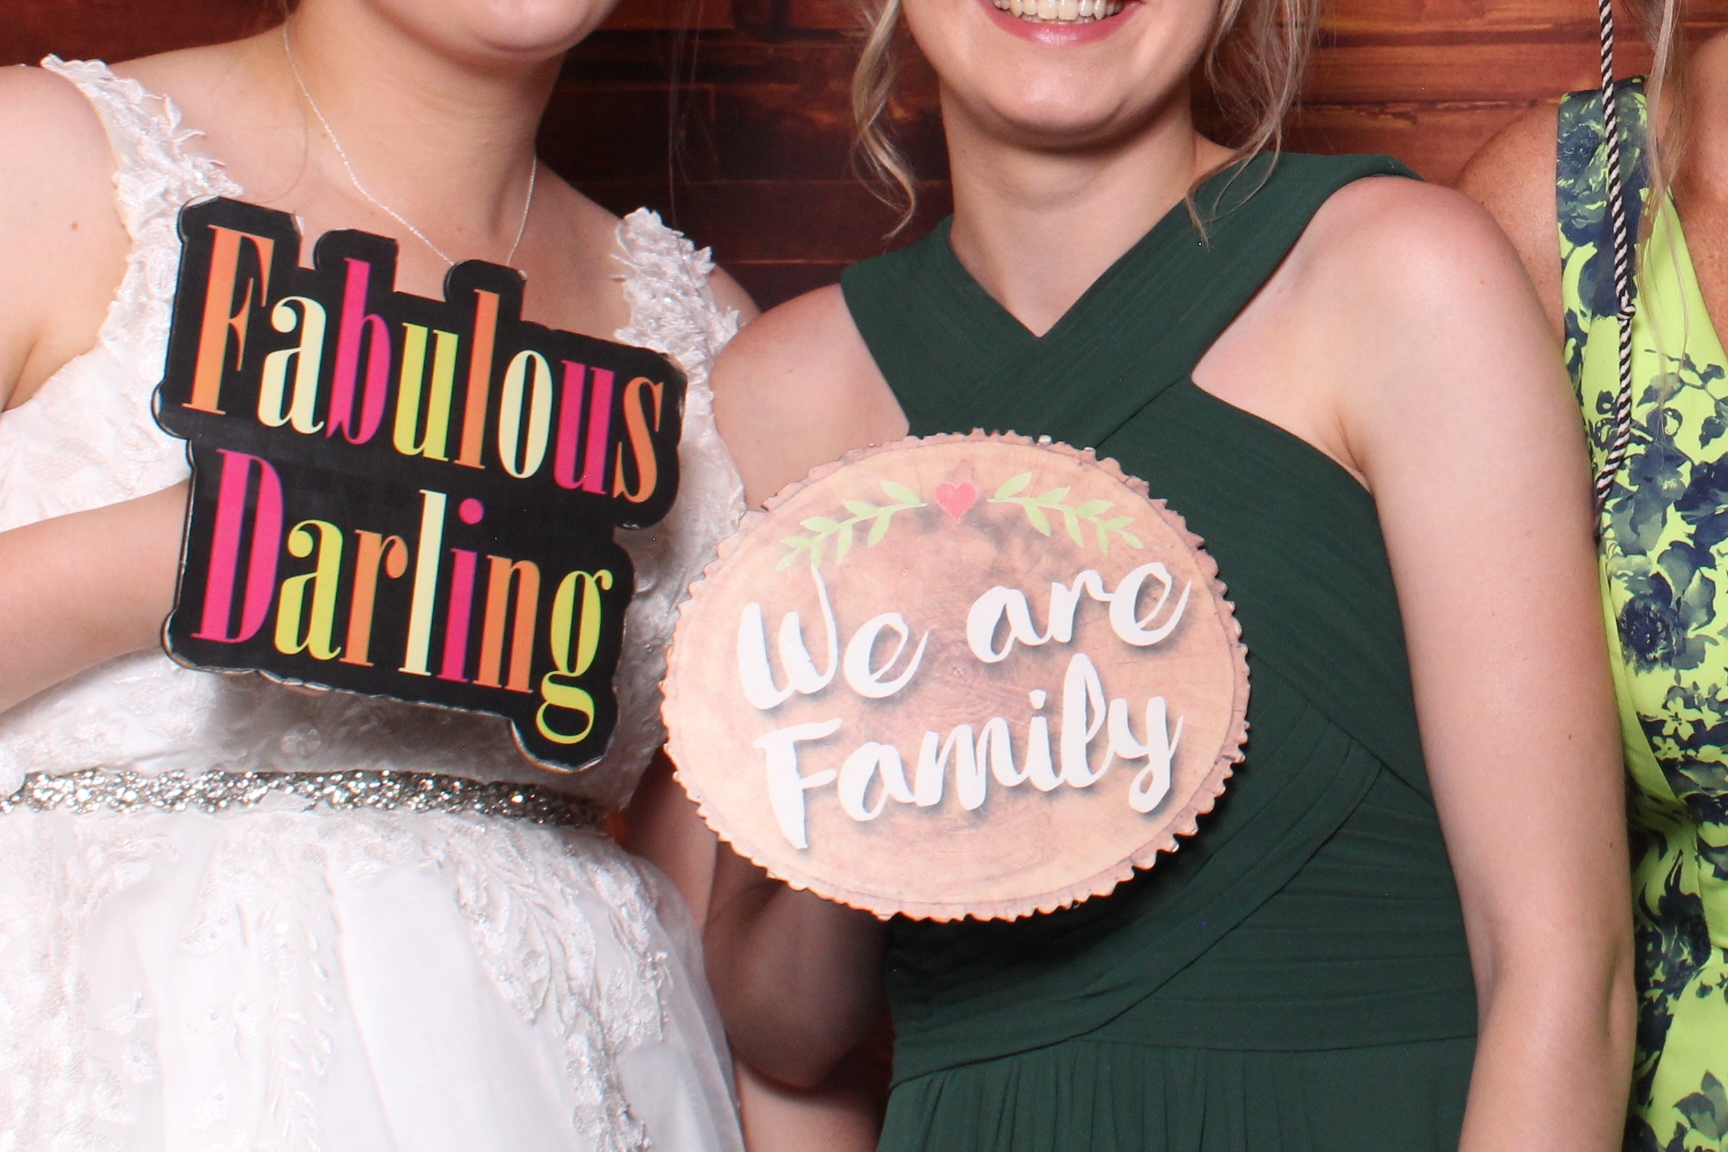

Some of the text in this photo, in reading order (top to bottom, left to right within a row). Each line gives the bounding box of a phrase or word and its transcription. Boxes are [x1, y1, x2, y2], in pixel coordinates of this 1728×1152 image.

[182, 225, 664, 503] Fabulous
[191, 449, 612, 744] Darling
[737, 562, 1191, 709] We are
[753, 653, 1184, 849] Family
